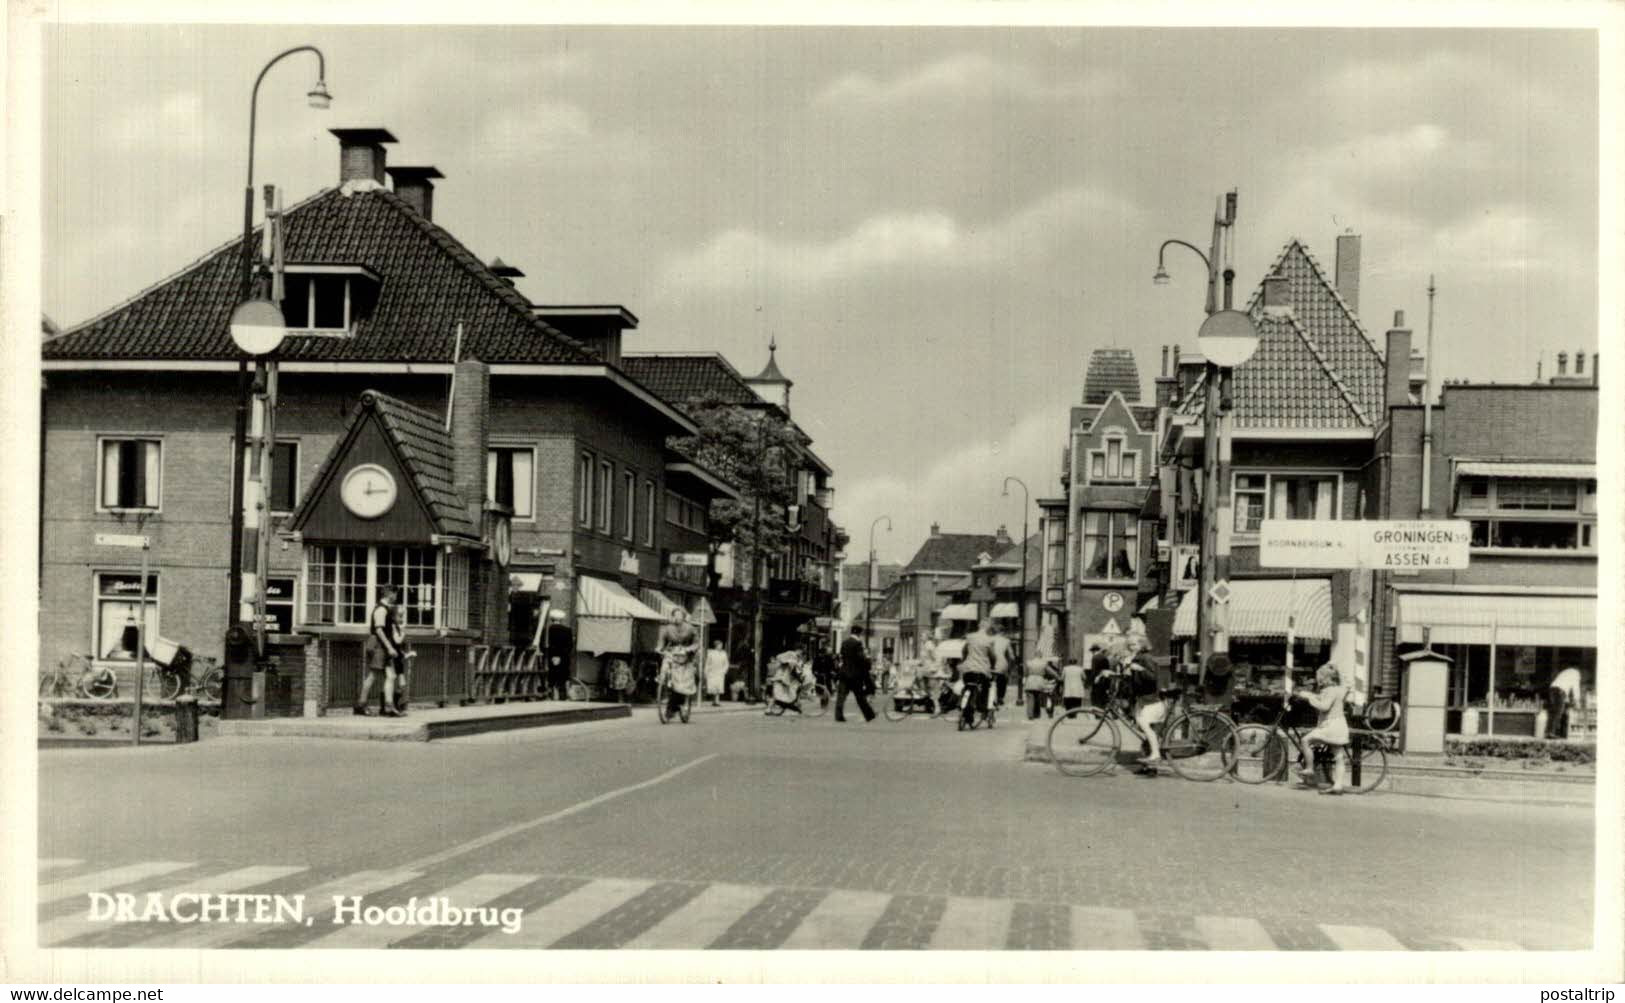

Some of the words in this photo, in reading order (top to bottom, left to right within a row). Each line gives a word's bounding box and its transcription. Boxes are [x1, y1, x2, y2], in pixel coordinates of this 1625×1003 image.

[1373, 530, 1453, 543] GRONINGEN
[1384, 553, 1430, 566] ASSEN
[1108, 594, 1120, 609] P
